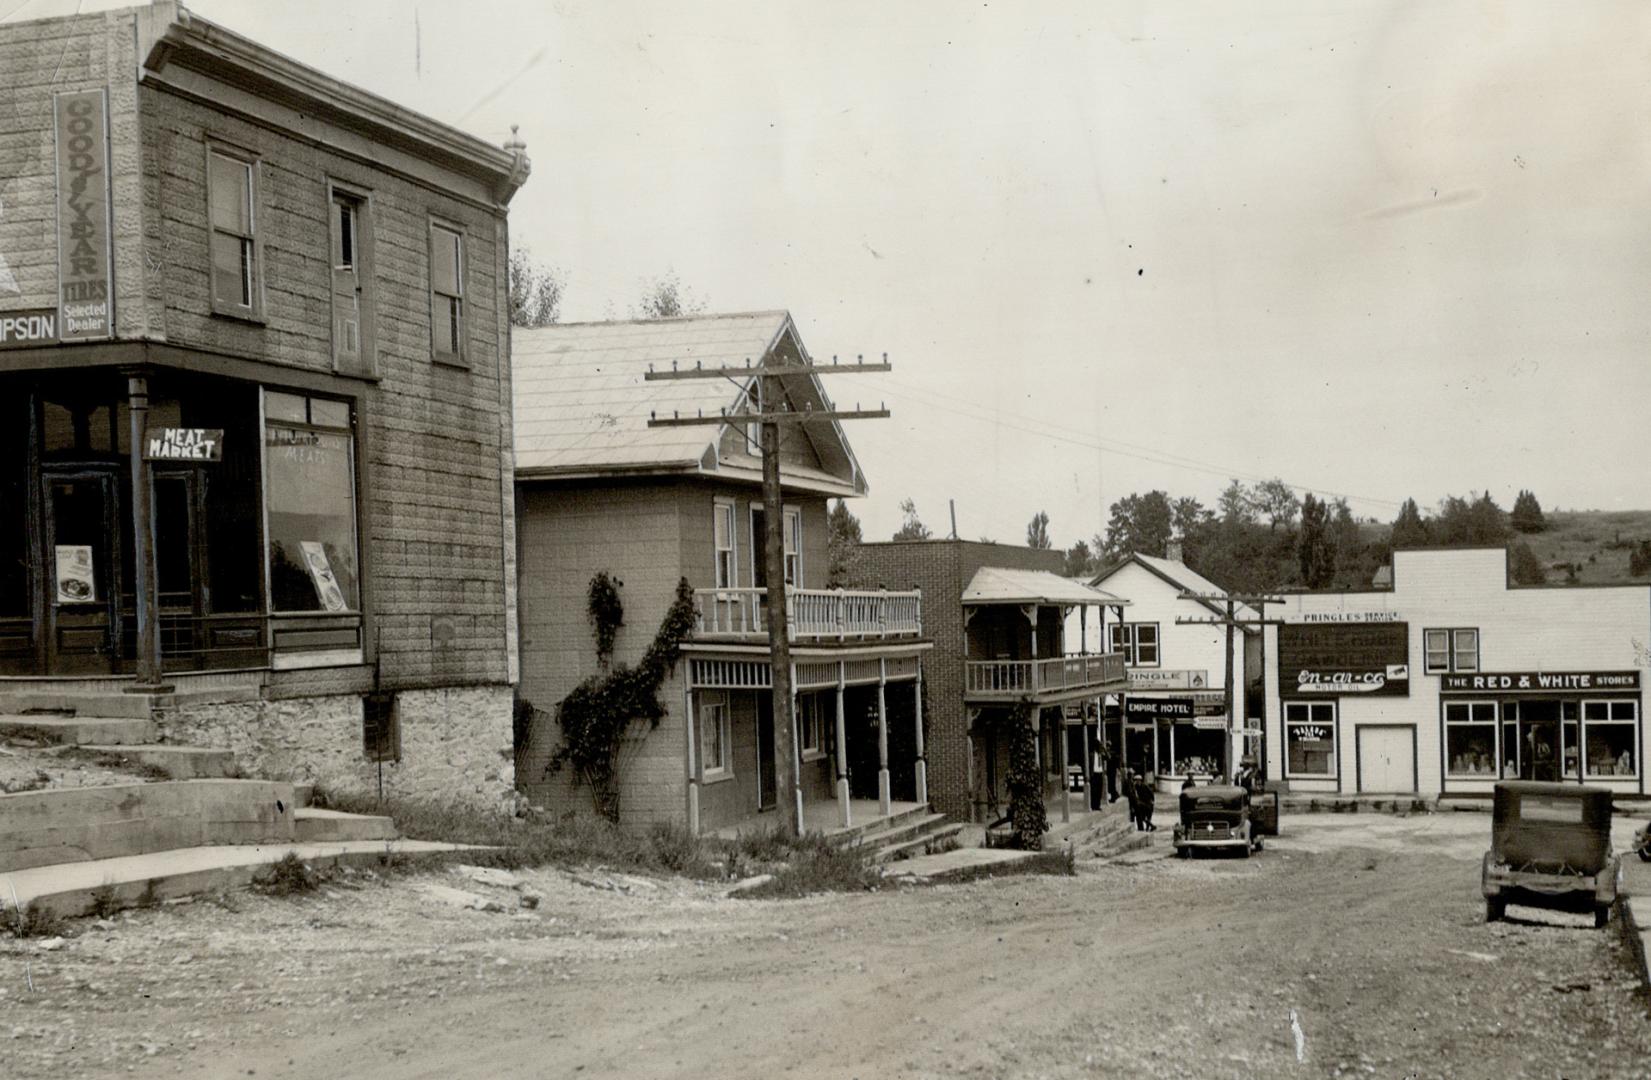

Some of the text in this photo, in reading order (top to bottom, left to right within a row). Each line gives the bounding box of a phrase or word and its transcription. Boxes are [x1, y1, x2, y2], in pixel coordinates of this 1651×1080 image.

[66, 100, 98, 276] GOODYEAR
[62, 279, 108, 303] TIRES
[64, 301, 106, 318] Selected
[67, 318, 105, 332] Dealer
[165, 428, 205, 445] MEAT
[149, 439, 215, 459] MARKET
[1448, 675, 1634, 689] THE RED & WHITE STORES
[1128, 703, 1158, 713] EMPIRE
[1160, 703, 1190, 714] HOTEL
